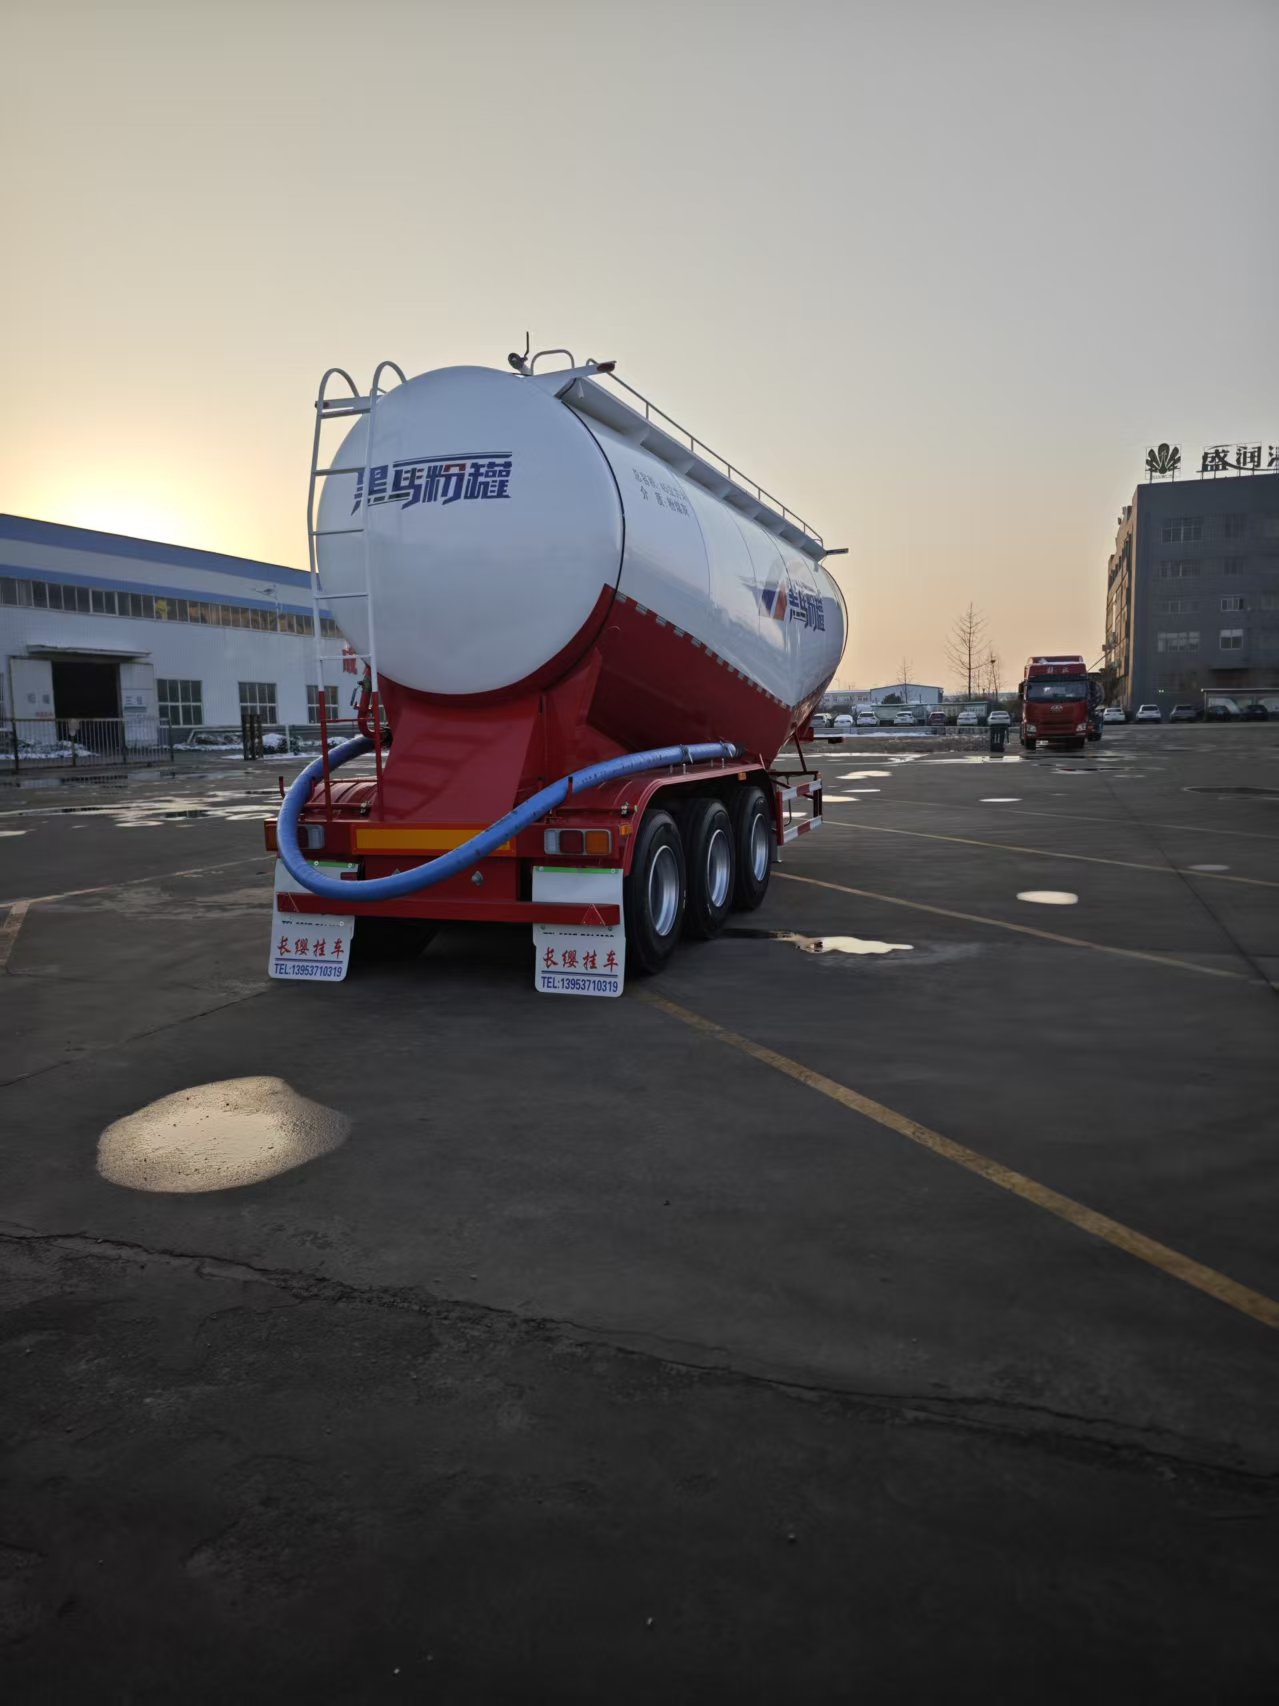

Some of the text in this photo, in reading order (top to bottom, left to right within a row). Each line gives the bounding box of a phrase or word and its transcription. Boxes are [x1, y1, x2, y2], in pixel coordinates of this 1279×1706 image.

[277, 935, 345, 959] 长缨挂车
[543, 946, 618, 972] 长缨挂车
[274, 963, 343, 978] TEL:13953710319
[541, 976, 618, 993] TEL:13953710319
